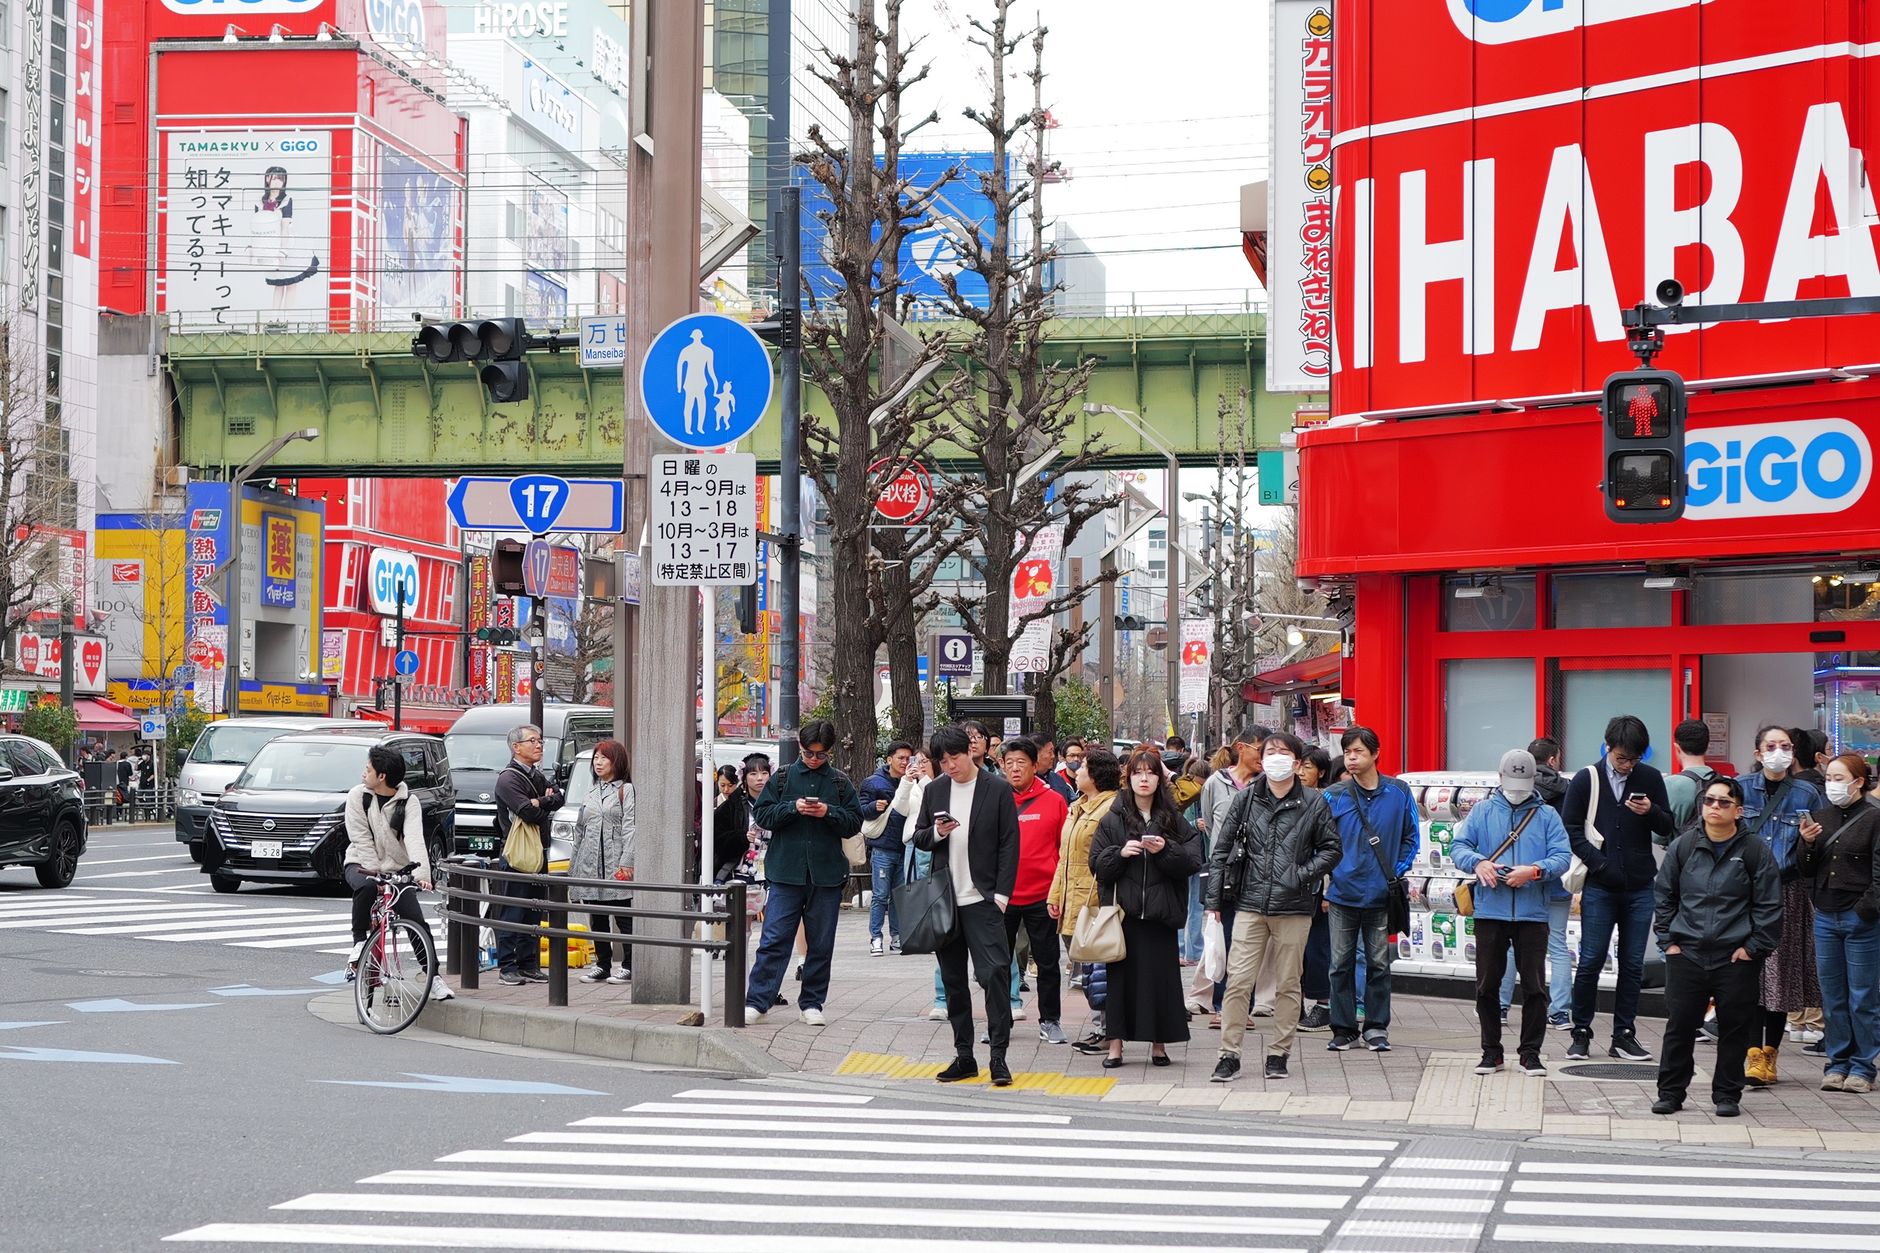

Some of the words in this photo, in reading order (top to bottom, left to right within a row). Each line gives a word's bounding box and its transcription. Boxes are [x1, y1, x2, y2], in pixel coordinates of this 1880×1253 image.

[280, 140, 318, 152] GiGO
[211, 166, 234, 325] タマキューって
[1302, 198, 1331, 376] まねきねこ
[663, 460, 718, 476] 日曜の
[1684, 431, 1862, 507] GiGO
[521, 484, 560, 519] 17
[1263, 491, 1278, 500] B1
[375, 559, 416, 606] GiGO
[535, 549, 548, 582] 17
[656, 563, 751, 580] (特定禁止区間)
